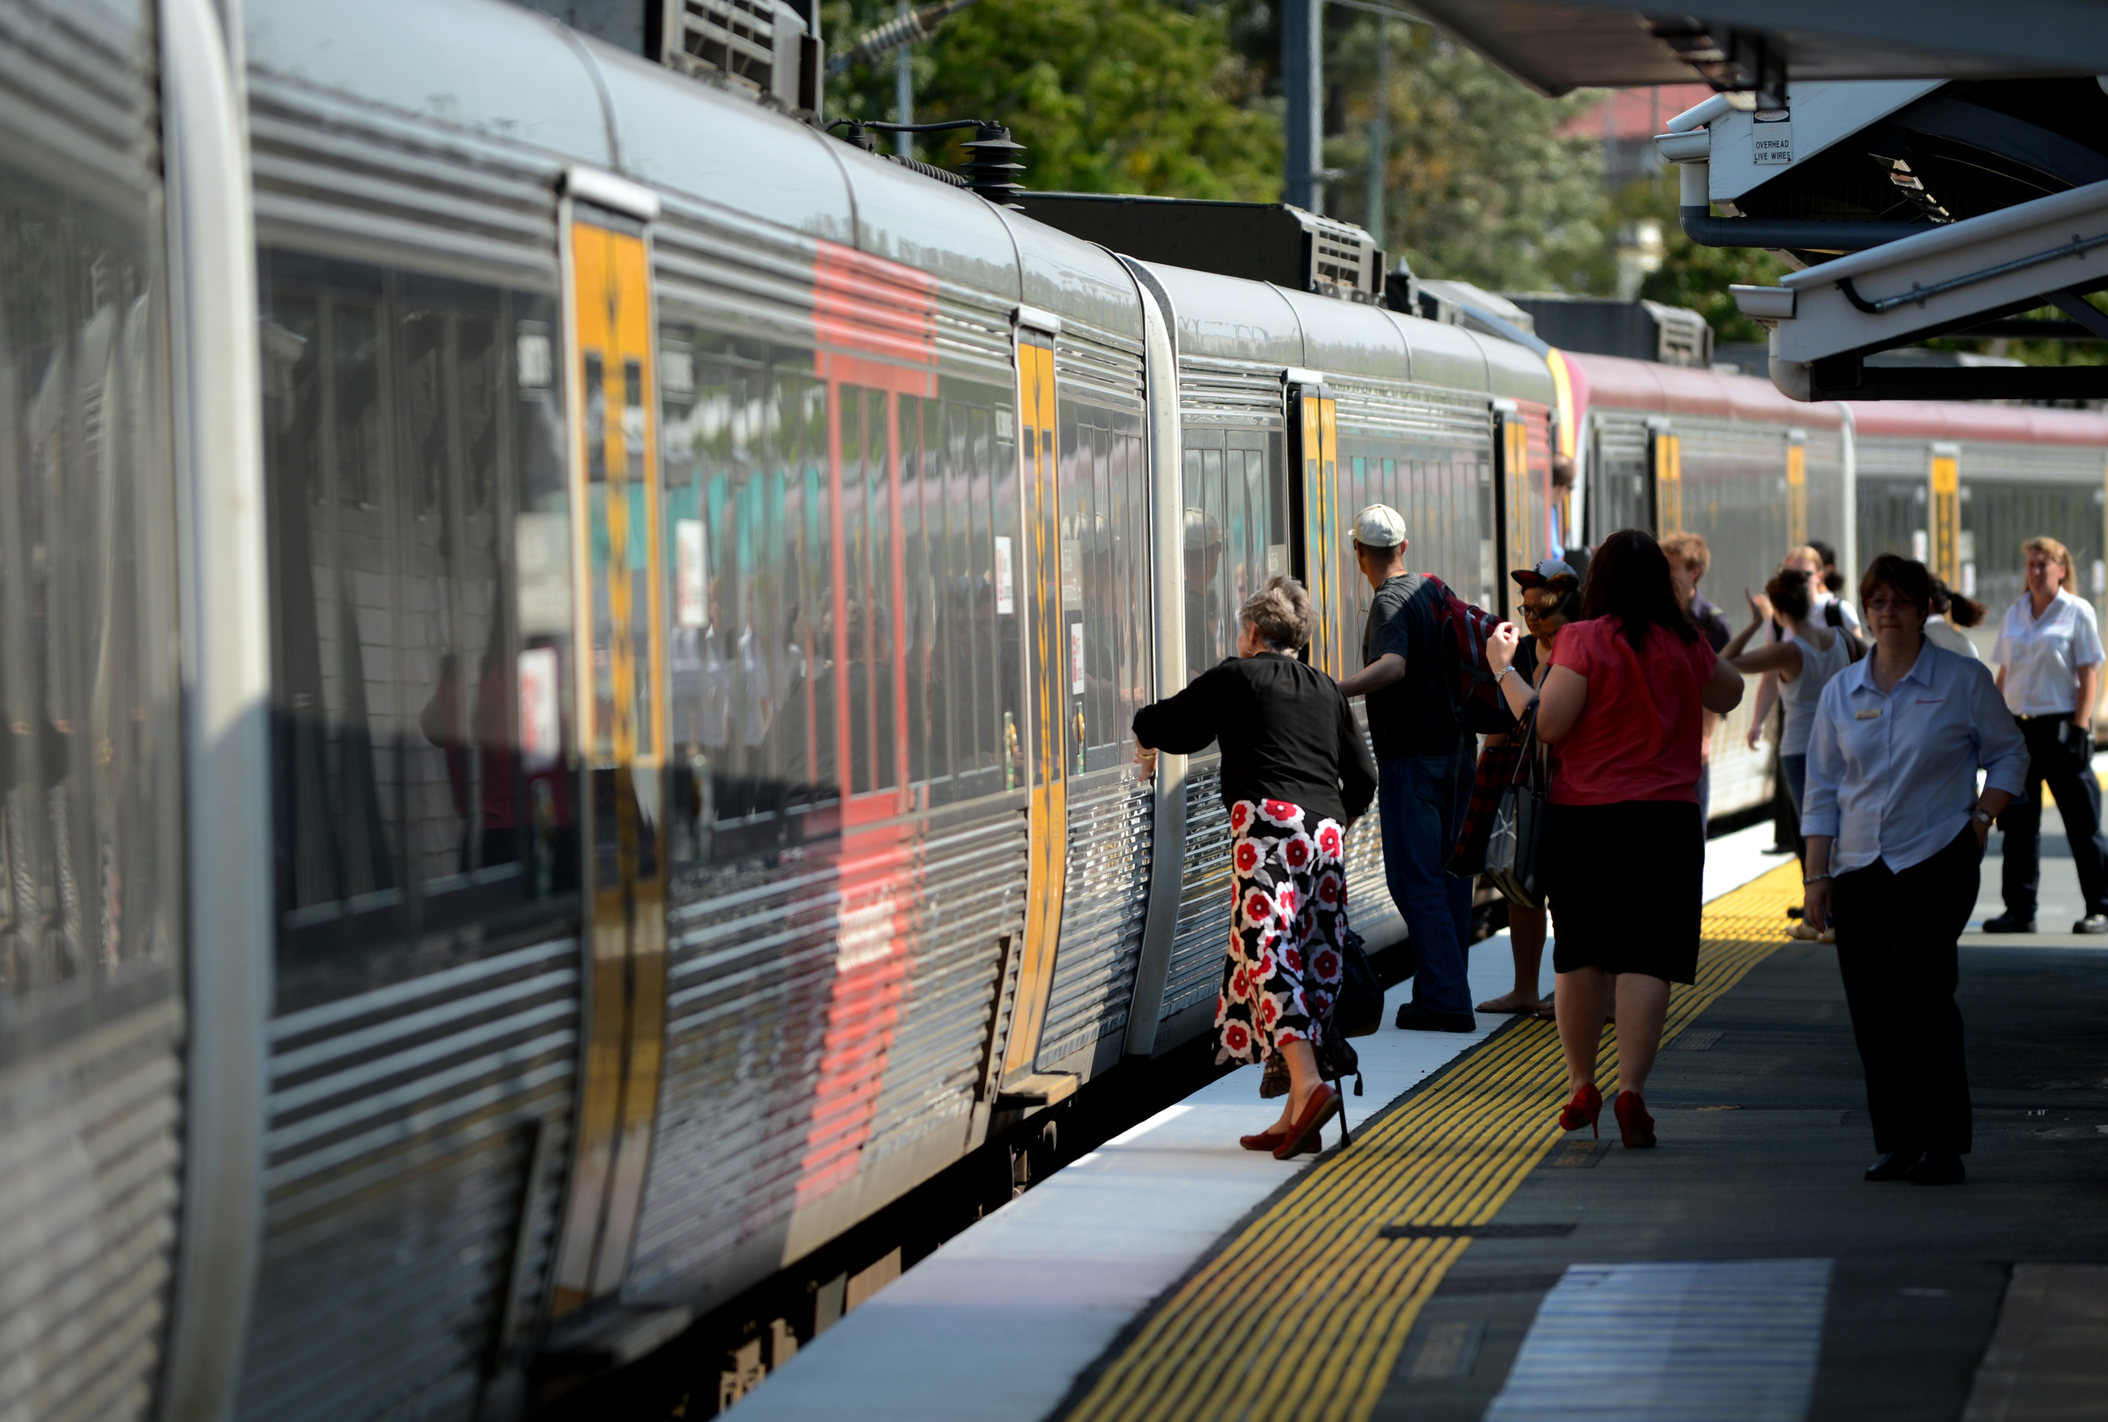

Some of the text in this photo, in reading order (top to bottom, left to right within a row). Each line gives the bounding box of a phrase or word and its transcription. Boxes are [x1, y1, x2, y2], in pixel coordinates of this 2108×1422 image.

[1755, 140, 1789, 149] OVERHEAD
[1754, 151, 1791, 160] LIVE WIRES
